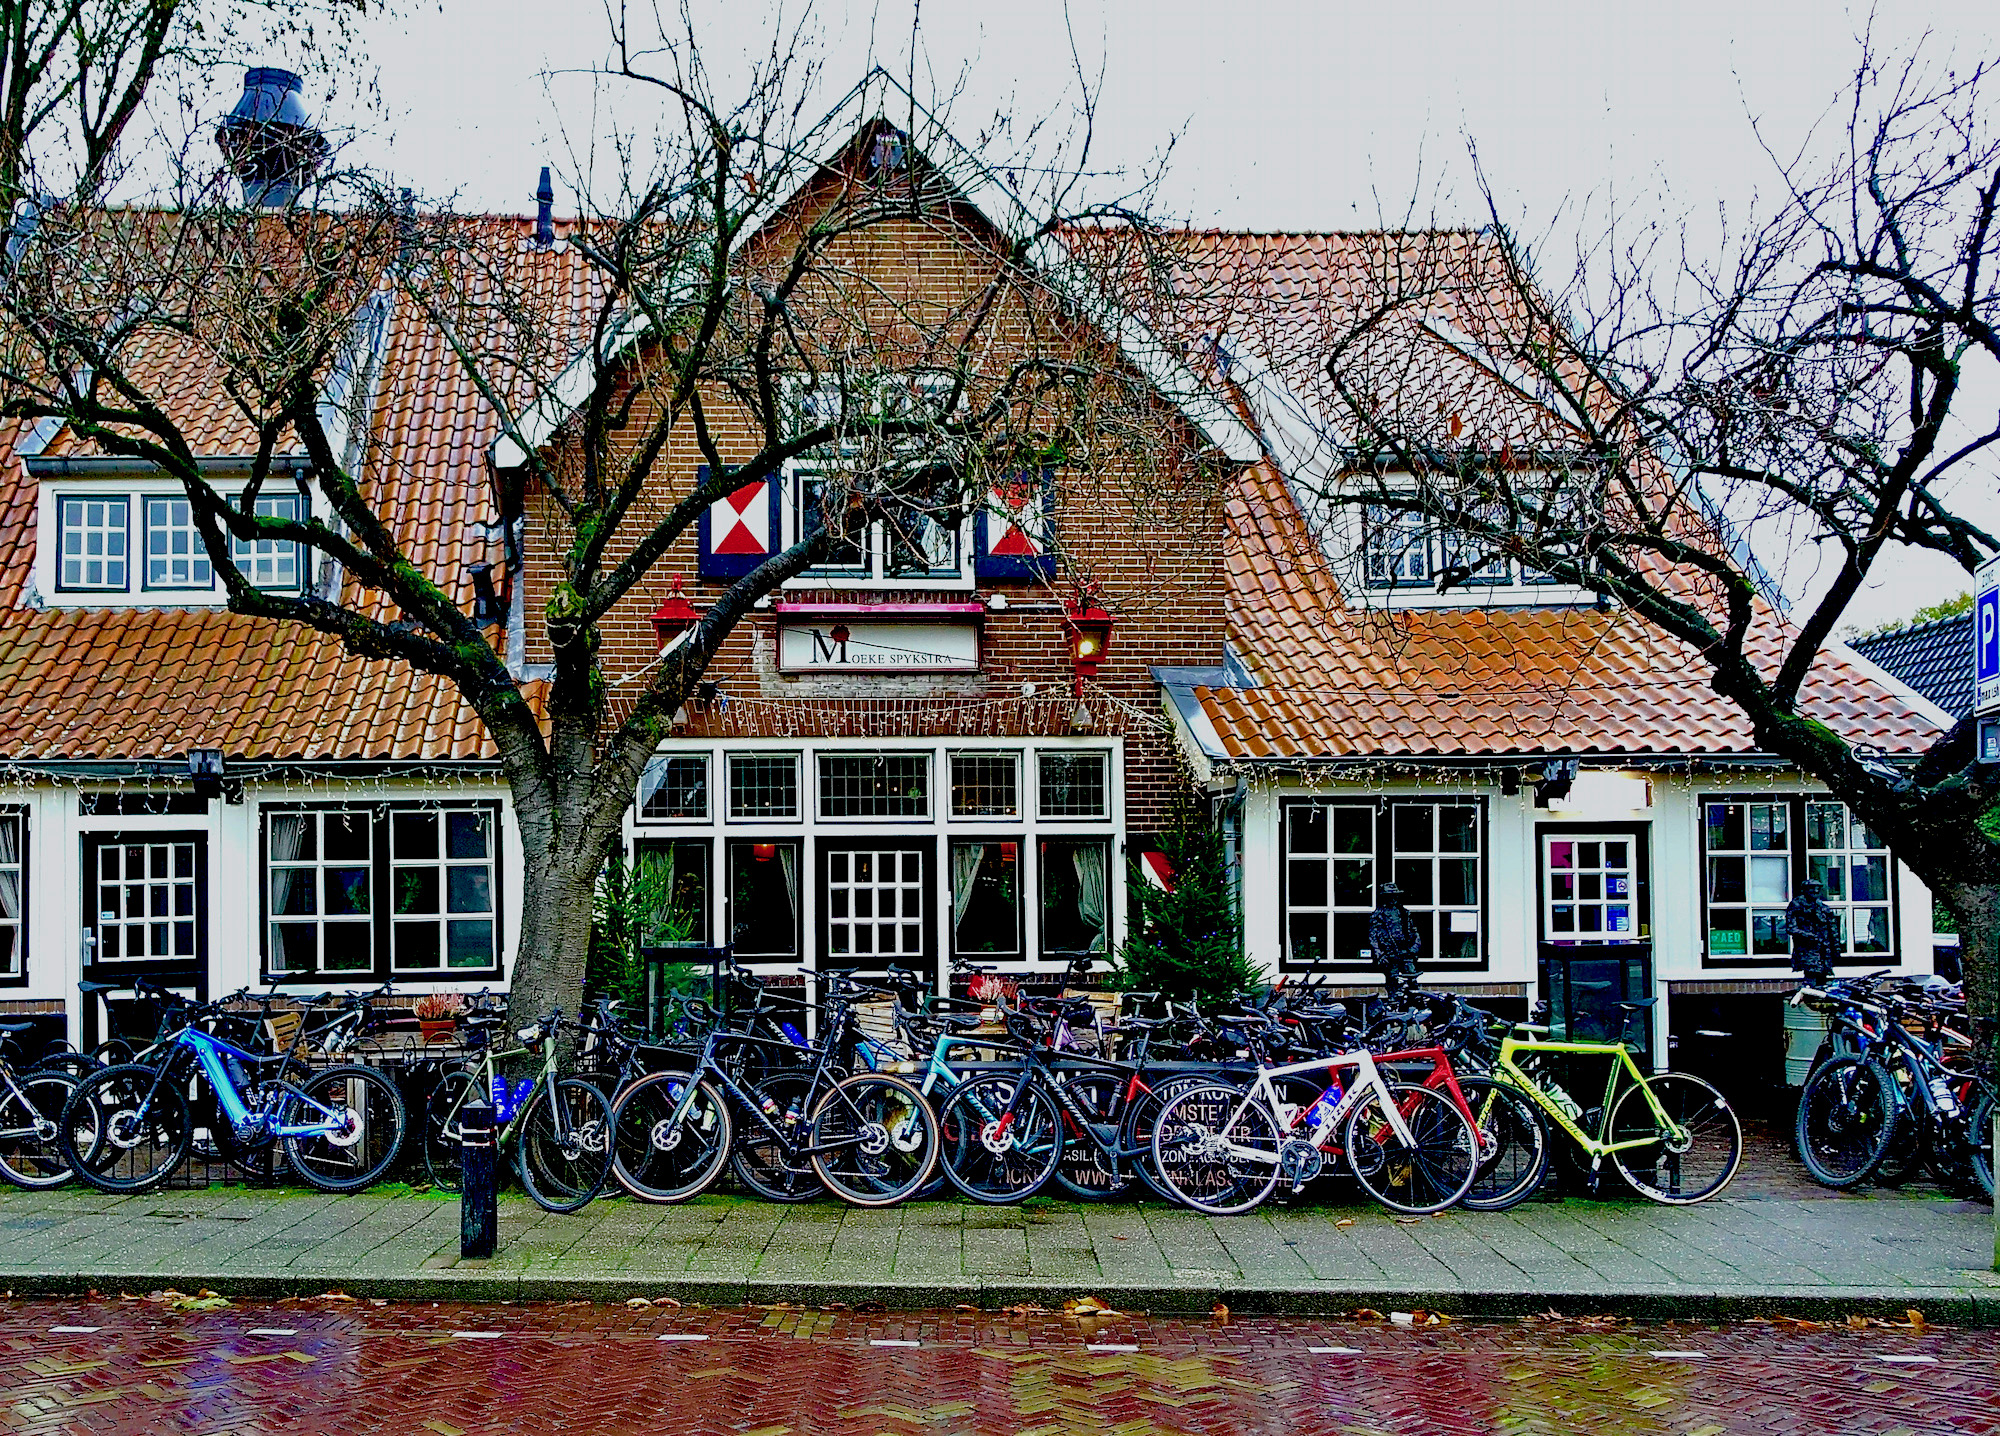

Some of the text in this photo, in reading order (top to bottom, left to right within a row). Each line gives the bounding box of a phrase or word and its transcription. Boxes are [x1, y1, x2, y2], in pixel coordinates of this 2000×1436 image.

[808, 628, 952, 664] MOEKE SPYKSTRA
[1982, 602, 1995, 670] P
[1721, 932, 1741, 943] AED
